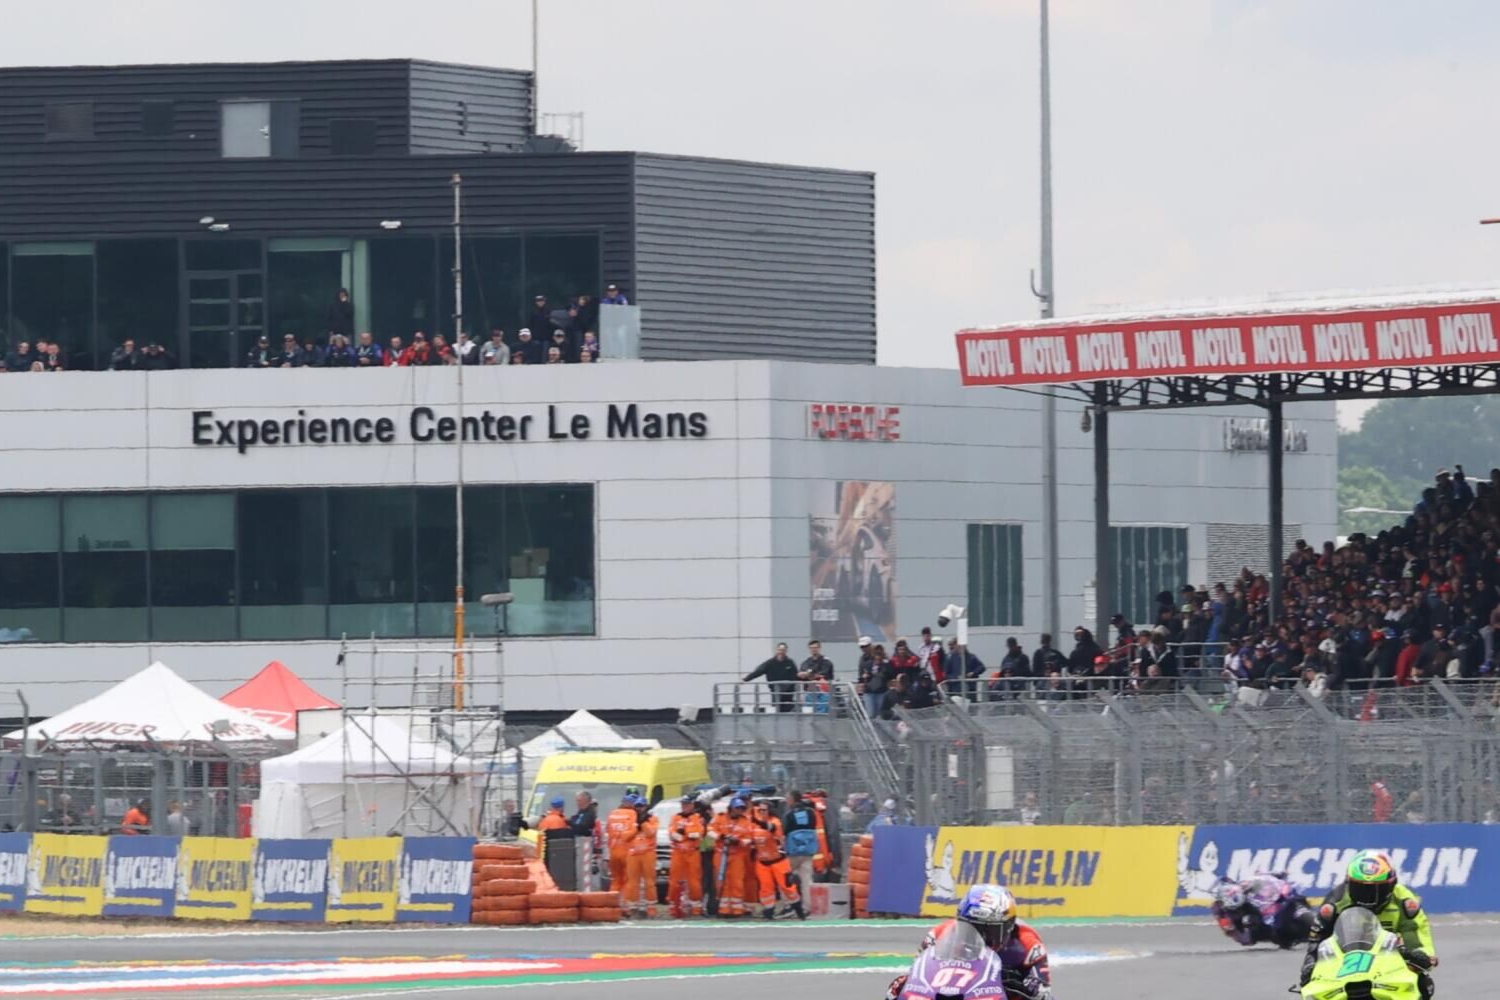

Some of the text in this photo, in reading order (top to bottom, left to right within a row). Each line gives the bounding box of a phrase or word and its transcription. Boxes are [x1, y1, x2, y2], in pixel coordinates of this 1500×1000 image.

[1076, 332, 1129, 372] MOTUL
[1134, 330, 1187, 369] MOTUL
[1192, 328, 1246, 366] MOTUL
[1252, 325, 1307, 364] MOTUL
[1313, 322, 1369, 363] MOTUL
[1375, 318, 1432, 360] MOTUL
[1438, 313, 1497, 355] MOTUL
[965, 339, 1015, 377] MOTUL
[1020, 336, 1072, 375] MOTUL
[192, 403, 708, 454] Experience Center Le Mans
[957, 850, 1100, 887] MICHELIN
[1226, 846, 1478, 888] MICHLIN
[930, 967, 978, 988] 07
[1336, 951, 1375, 978] 21
